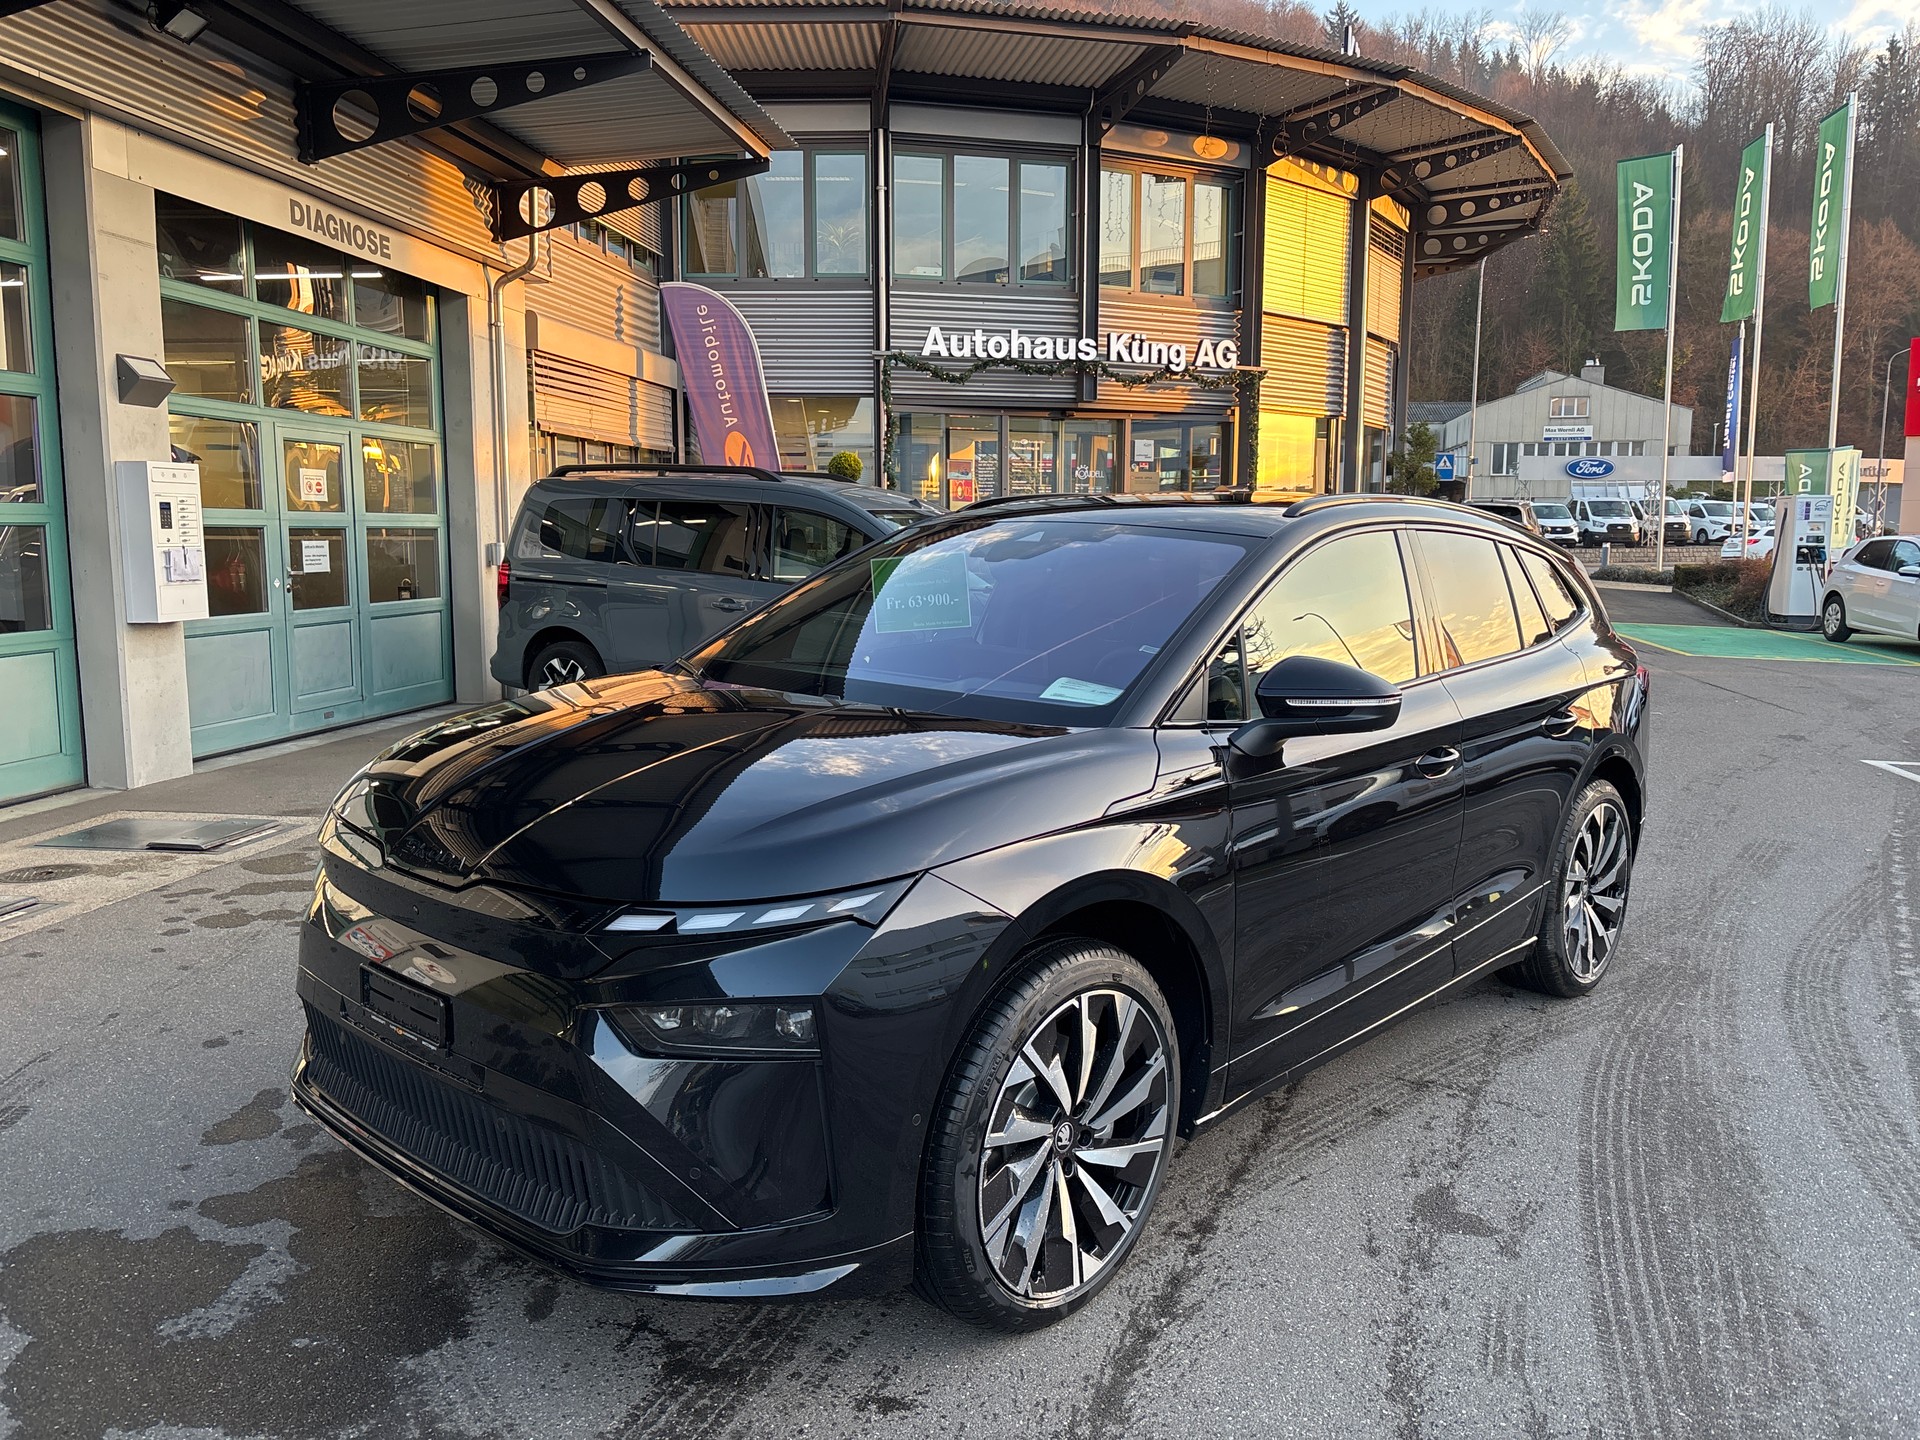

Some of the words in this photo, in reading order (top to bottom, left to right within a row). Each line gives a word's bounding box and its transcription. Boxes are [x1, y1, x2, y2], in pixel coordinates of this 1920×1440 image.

[289, 198, 392, 260] DIAGNOSE
[921, 326, 1098, 361] Autohaus
[1108, 332, 1188, 372] Küng
[1195, 338, 1238, 369] AG
[1575, 460, 1607, 474] Ford
[886, 597, 905, 610] Fr.
